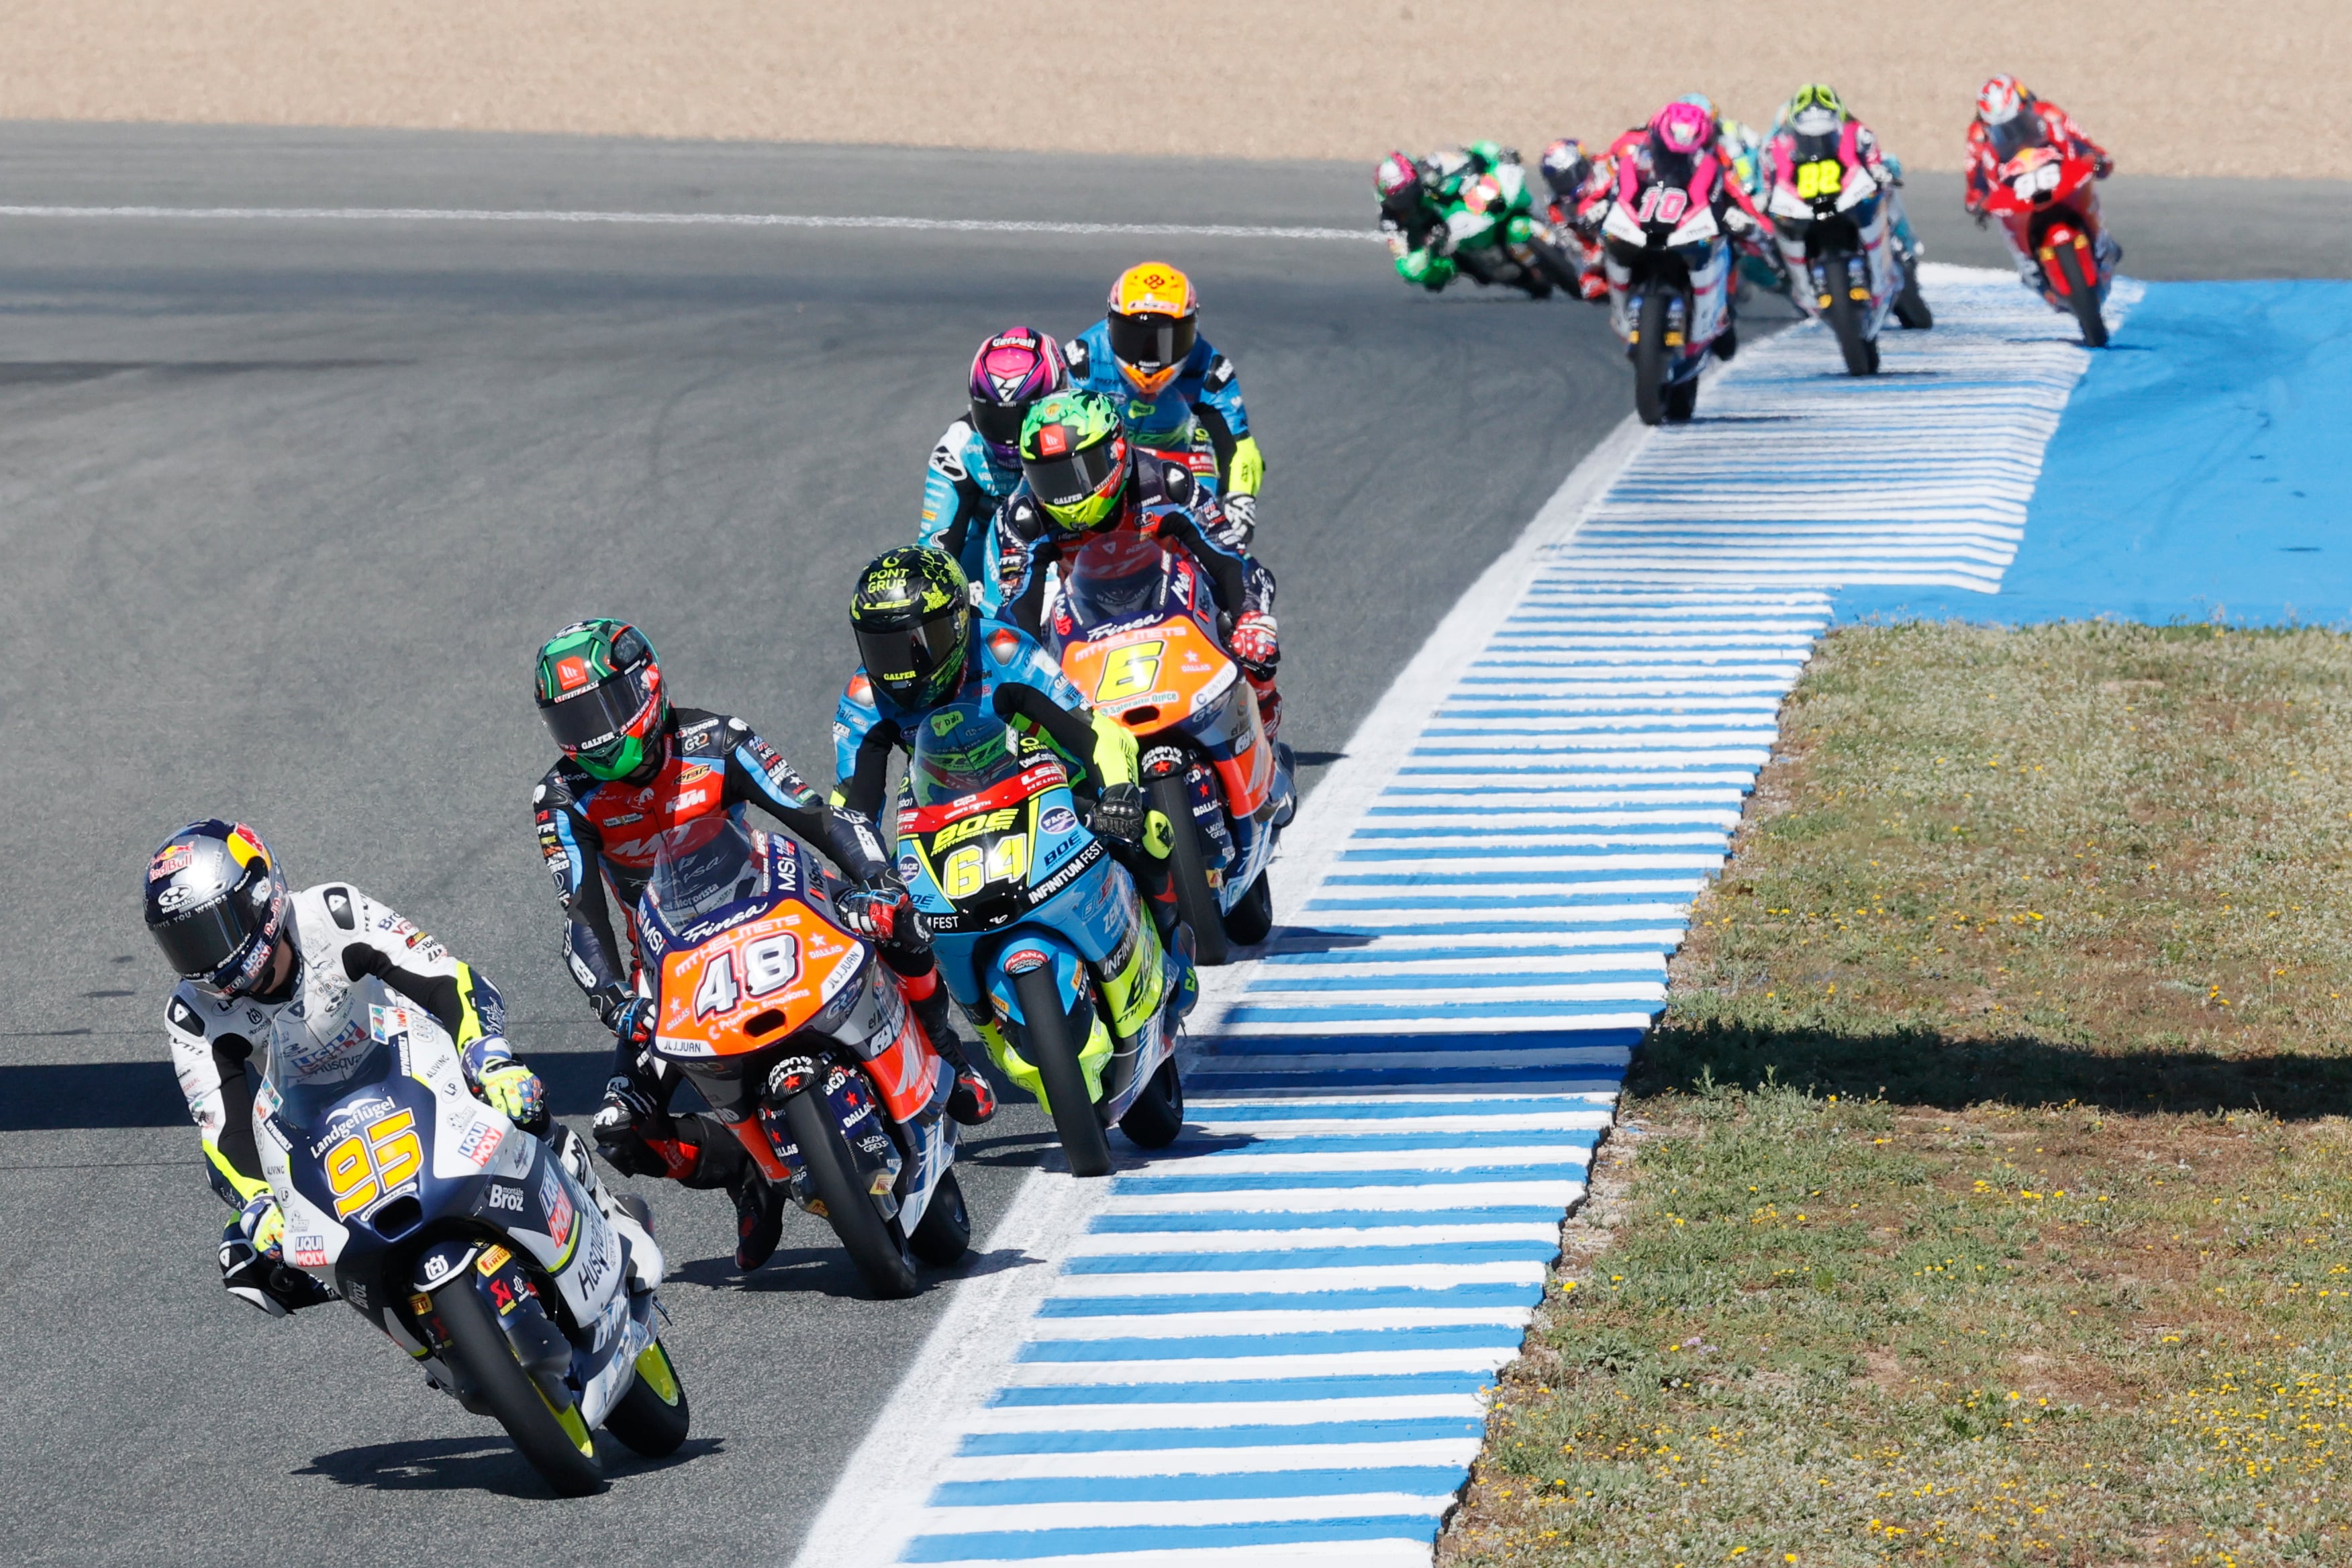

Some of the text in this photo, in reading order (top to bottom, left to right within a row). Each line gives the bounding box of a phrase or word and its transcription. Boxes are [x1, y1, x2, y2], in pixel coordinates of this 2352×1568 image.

[1638, 187, 1687, 224] 10
[1054, 493, 1083, 505] GALFER
[869, 569, 910, 582] PONT
[867, 579, 907, 593] GRUP
[863, 599, 911, 609] LS2
[1087, 613, 1164, 642] Frinsa
[883, 671, 916, 681] GALFER
[1095, 640, 1165, 703] 6
[1181, 664, 1211, 672] DALLAS
[581, 732, 616, 750] GALFER
[1021, 766, 1062, 785] LS2
[665, 789, 707, 814] KTM
[1043, 810, 1072, 827] FACE
[168, 854, 193, 871] Bull
[942, 832, 1028, 900] 64
[1028, 858, 1086, 904] INFINITUM
[1079, 840, 1104, 865] FEST
[161, 897, 195, 914] Kabuto
[173, 911, 192, 924] YOU
[194, 893, 228, 914] WINGS
[682, 901, 768, 943] Frinsa
[932, 916, 959, 930] FEST
[246, 944, 273, 979] MOLY
[808, 944, 844, 960] DALLAS
[1004, 952, 1046, 971] PLANA
[695, 932, 797, 1020] 48
[718, 989, 811, 1031] Printing Emotions
[666, 1008, 691, 1032] DALLAS
[673, 1041, 701, 1053] J.JUAN
[771, 1065, 815, 1094] DALLAS
[444, 1083, 458, 1097] LP
[309, 1095, 397, 1160] Landgeflügel
[458, 1122, 490, 1158] LIQUI
[471, 1127, 503, 1168] MOLY
[863, 1139, 889, 1153] GROUP
[325, 1108, 424, 1224] 95
[295, 1235, 324, 1252] LIQUI
[296, 1251, 328, 1267] MOLY
